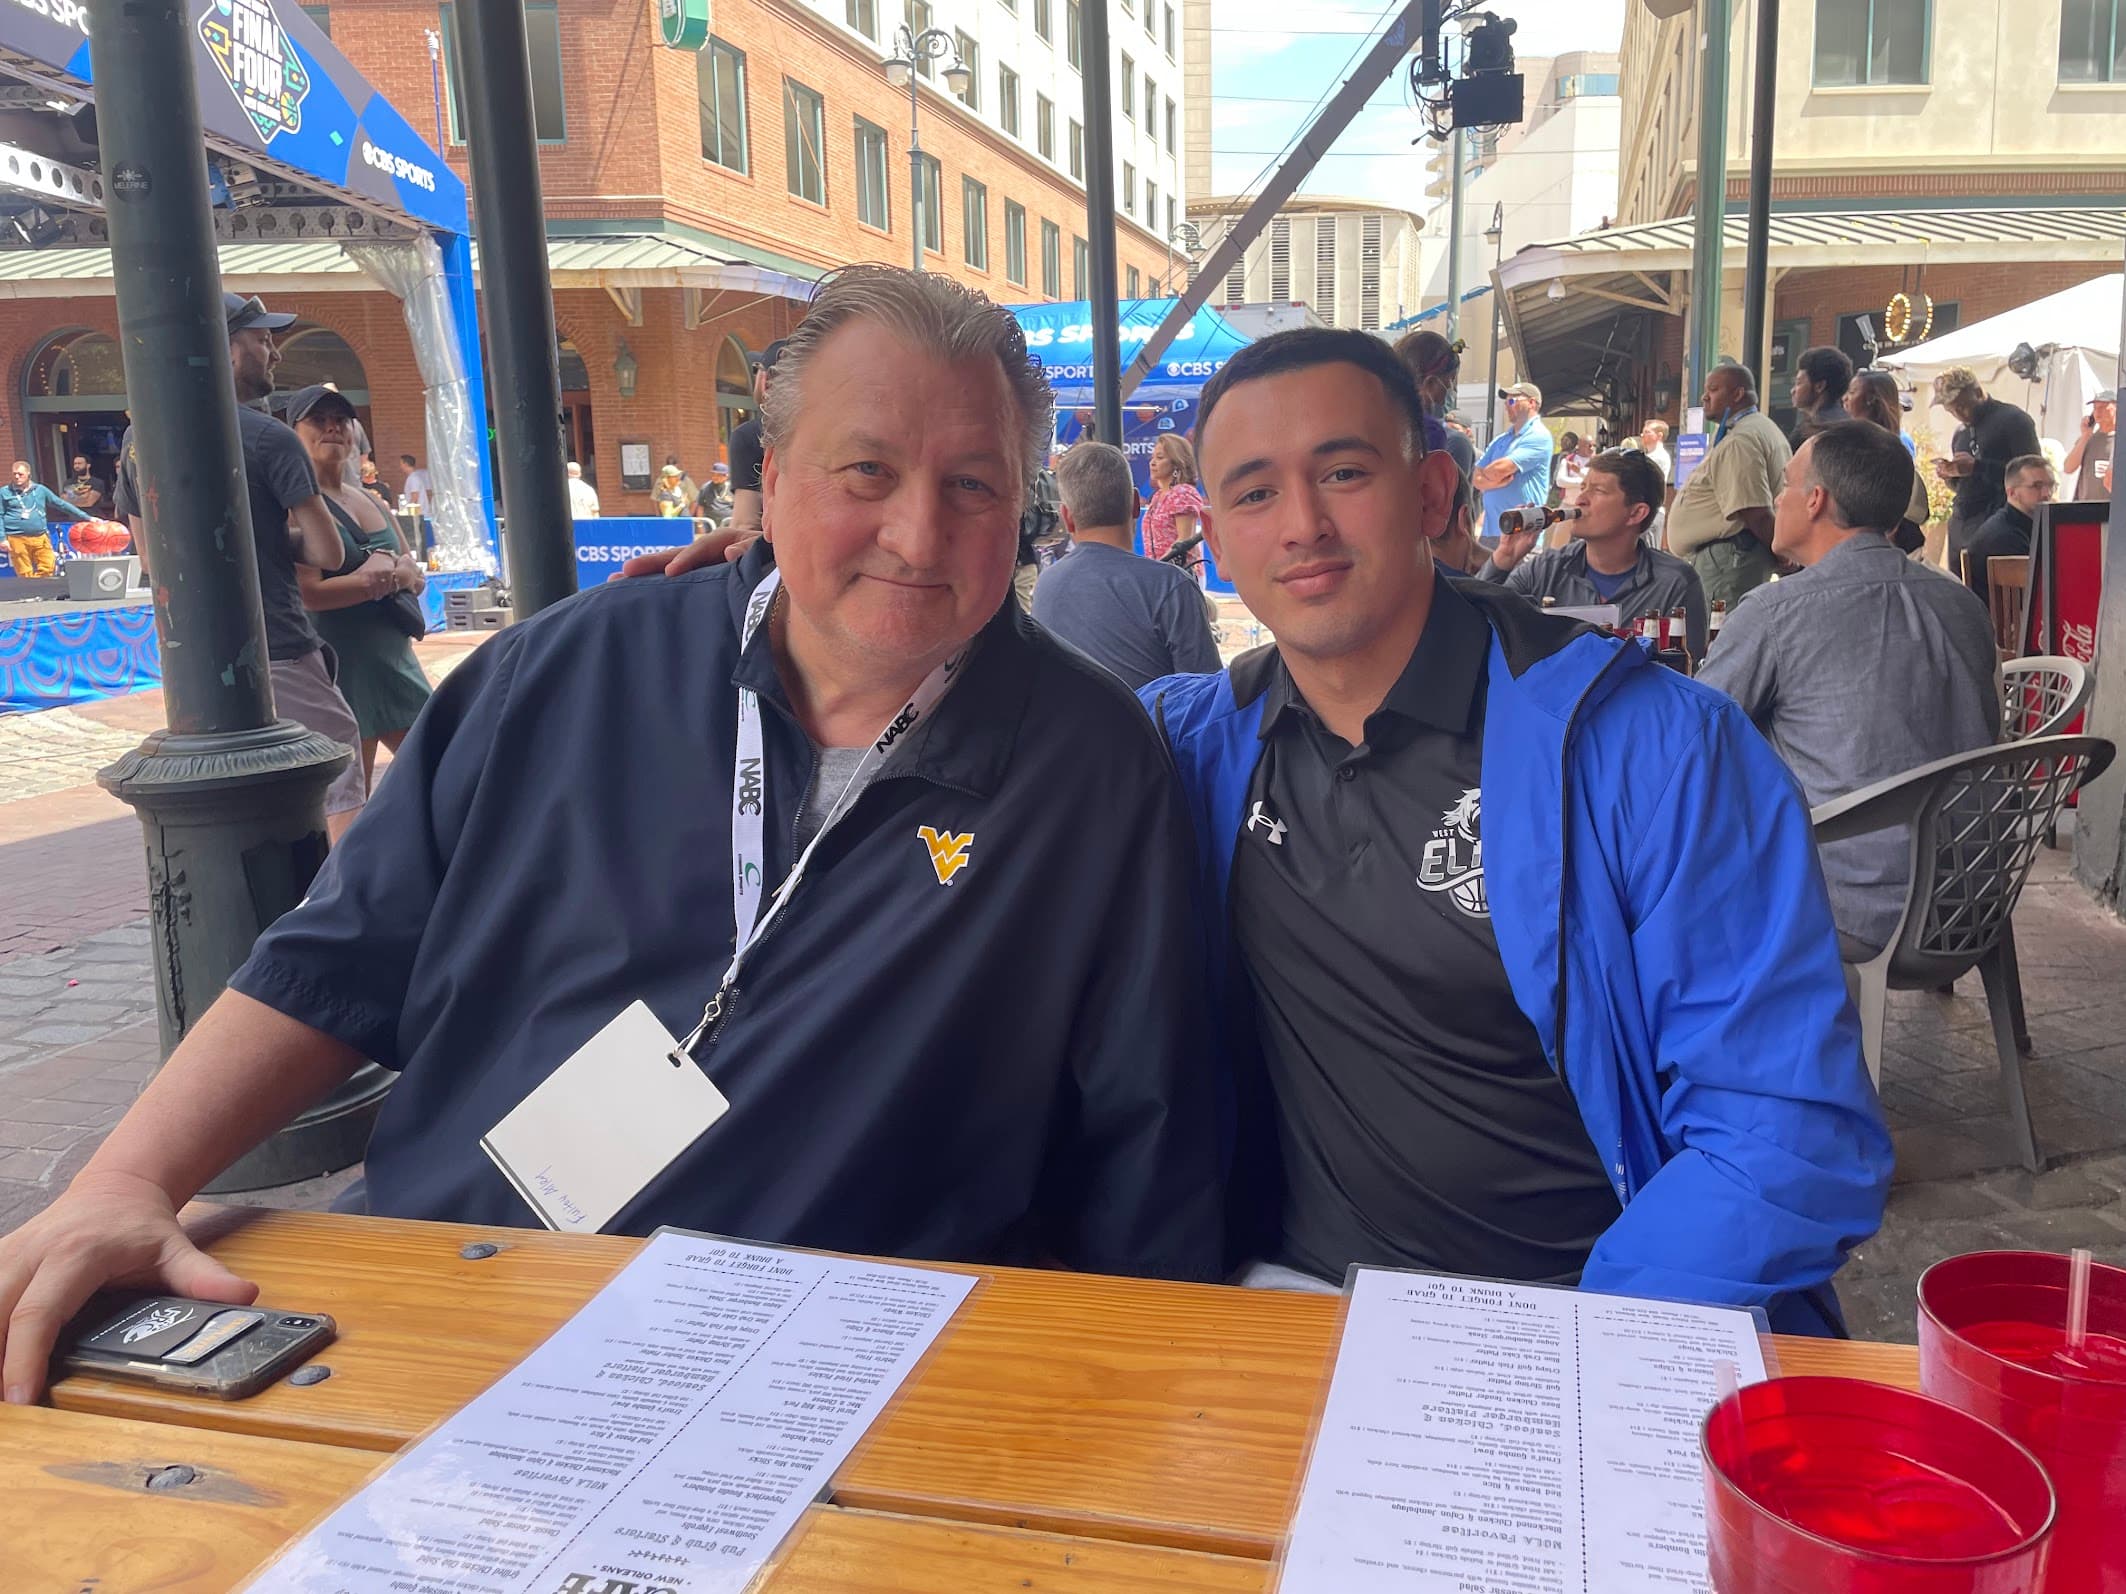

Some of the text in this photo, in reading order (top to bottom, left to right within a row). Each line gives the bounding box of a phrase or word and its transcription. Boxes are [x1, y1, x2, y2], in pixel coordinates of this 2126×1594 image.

[233, 1, 283, 62] FINAL
[233, 41, 283, 101] FOUR
[373, 146, 436, 193] CBS SPORTS
[1046, 365, 1094, 379] SPORT
[1180, 362, 1212, 376] CBS
[1123, 442, 1155, 455] ORTS
[578, 545, 609, 562] CBS
[876, 702, 920, 754] NABC
[738, 758, 762, 816] NABC
[1420, 838, 1482, 882] ELI
[1406, 1289, 1536, 1310] DONT FORGET TO GRAB
